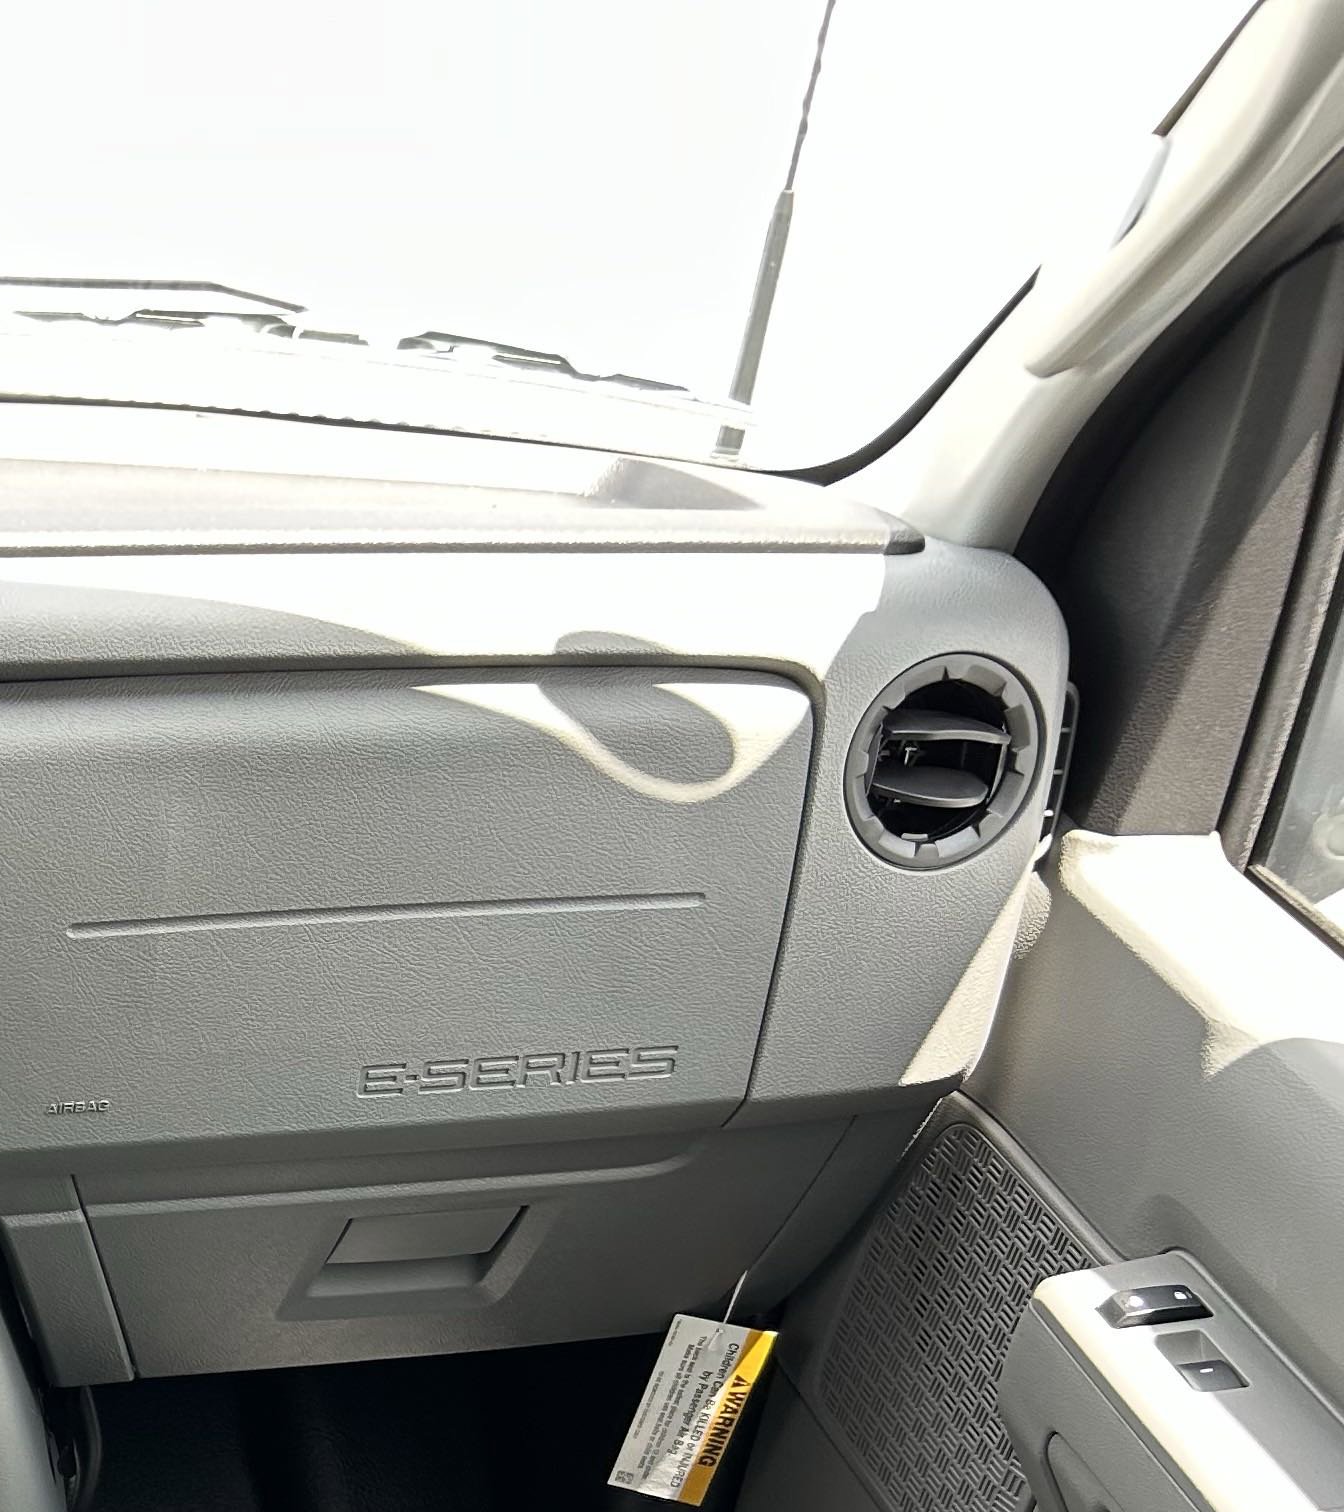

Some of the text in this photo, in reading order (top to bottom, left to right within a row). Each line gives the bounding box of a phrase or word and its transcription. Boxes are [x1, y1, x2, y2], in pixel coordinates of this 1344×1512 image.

[357, 1046, 679, 1098] E-SERIES
[47, 1099, 110, 1115] AIRBAG
[716, 1342, 740, 1380] Children
[690, 1411, 711, 1442] KILLED
[698, 1391, 747, 1467] WARNING
